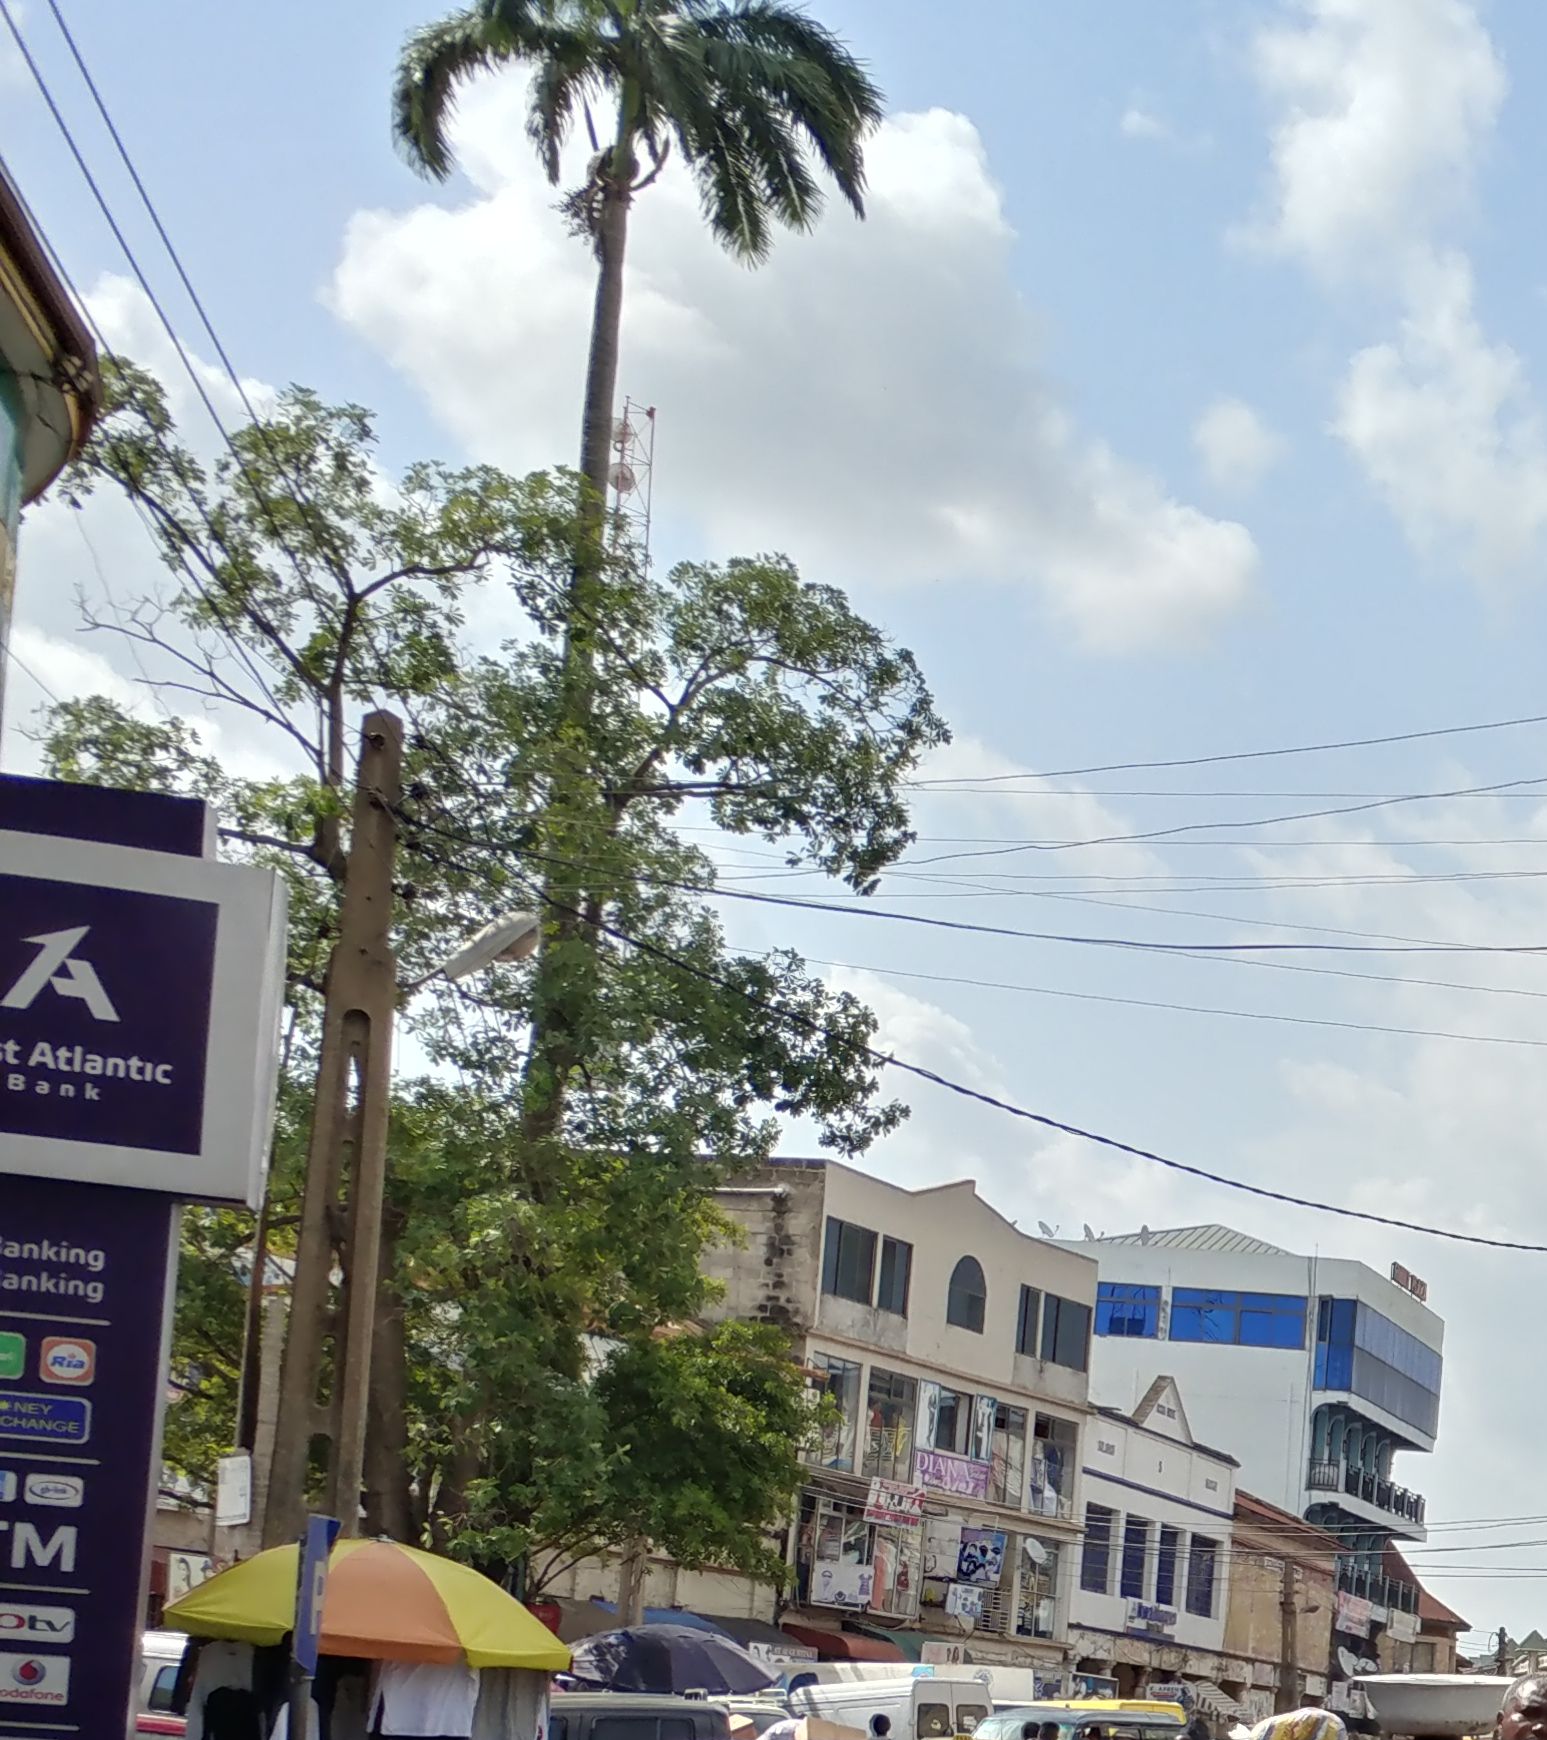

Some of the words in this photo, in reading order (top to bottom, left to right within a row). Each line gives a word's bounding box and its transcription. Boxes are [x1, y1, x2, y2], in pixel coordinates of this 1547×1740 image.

[27, 1041, 173, 1084] Atlantic
[7, 1073, 101, 1100] Bank
[0, 1237, 106, 1272] anking
[0, 1271, 105, 1303] anking
[51, 1354, 86, 1369] Ria
